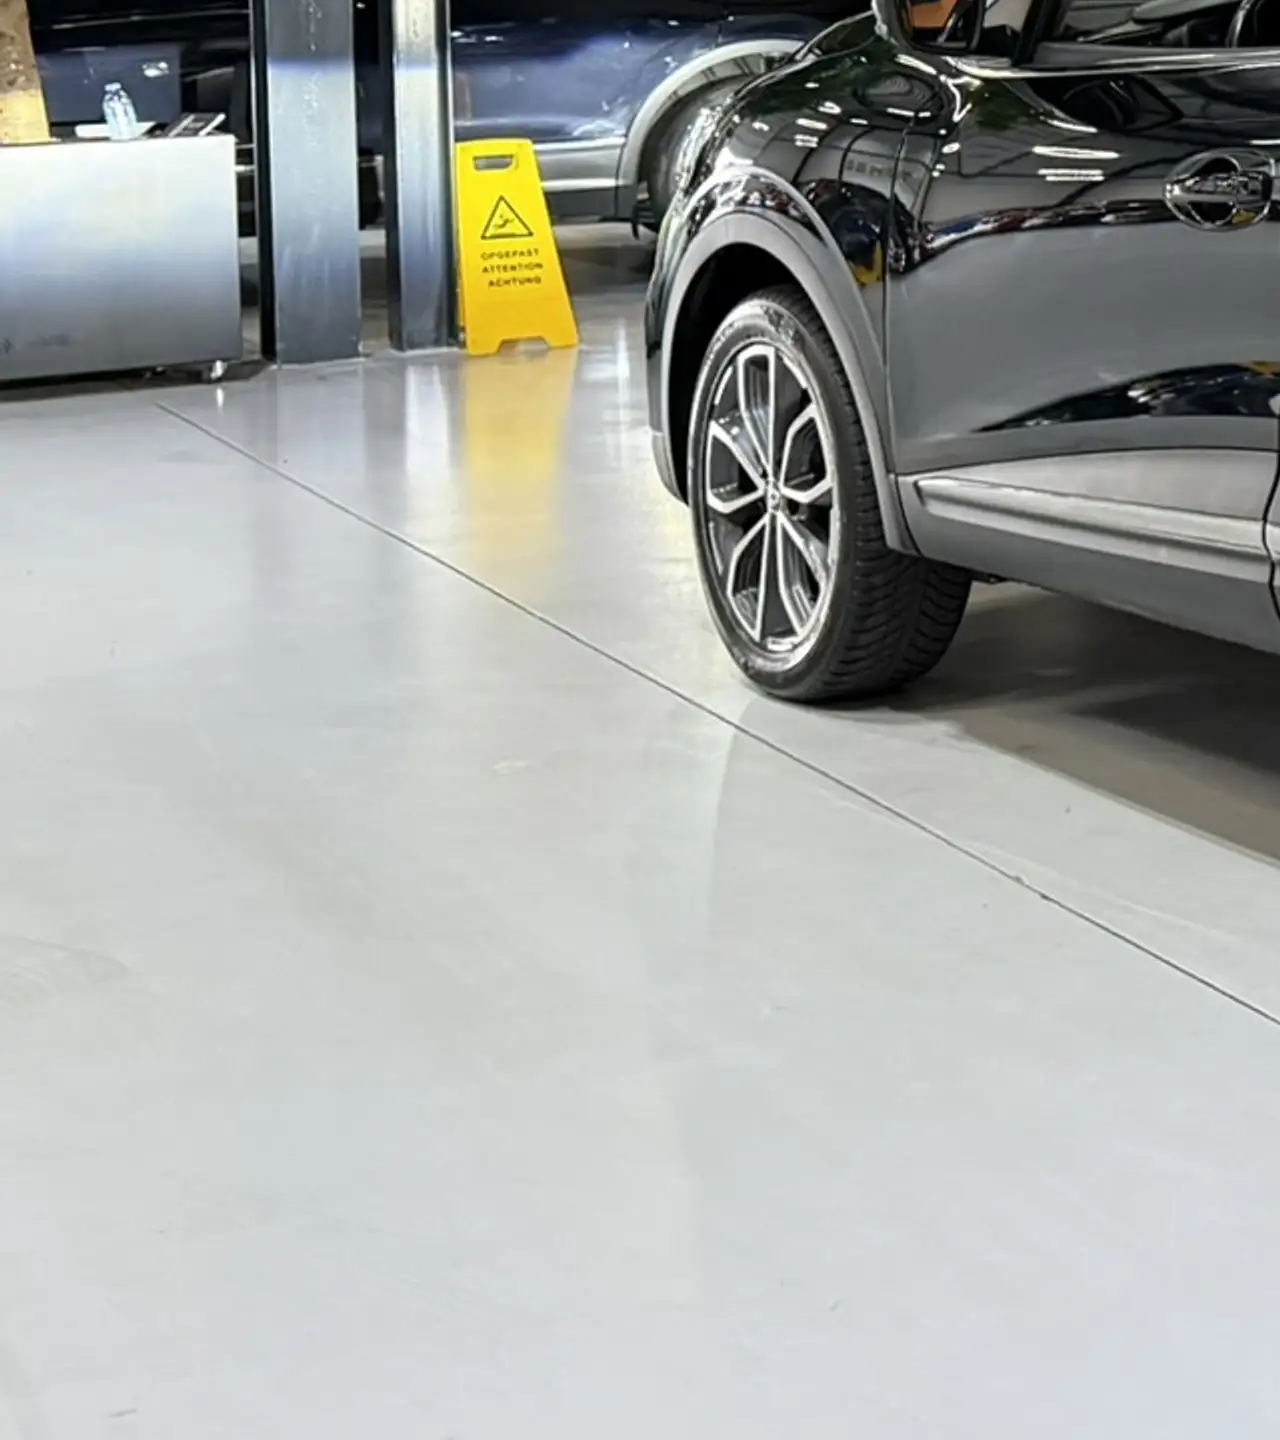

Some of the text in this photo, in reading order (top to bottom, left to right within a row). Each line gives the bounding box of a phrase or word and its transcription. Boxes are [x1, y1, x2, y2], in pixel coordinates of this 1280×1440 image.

[481, 248, 539, 260] OPGEPAST
[482, 262, 543, 274] ATTENTION
[488, 276, 542, 288] ACHTUNG
